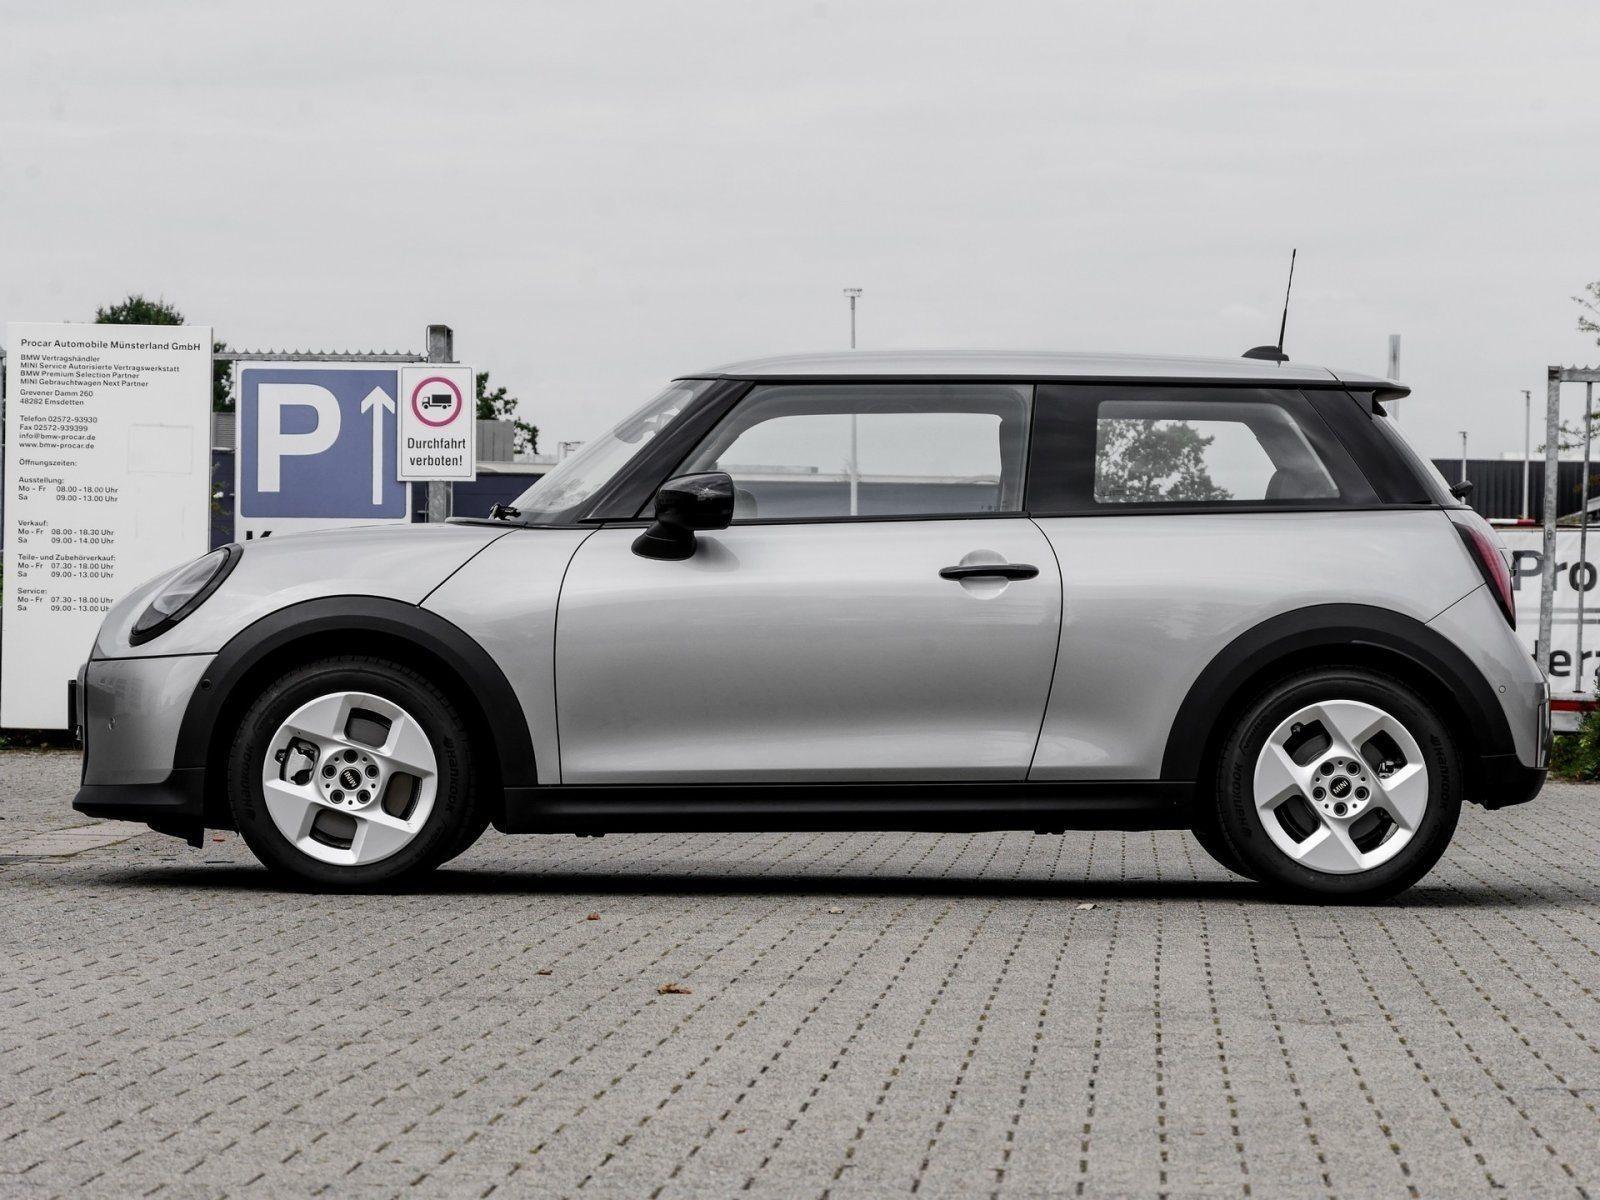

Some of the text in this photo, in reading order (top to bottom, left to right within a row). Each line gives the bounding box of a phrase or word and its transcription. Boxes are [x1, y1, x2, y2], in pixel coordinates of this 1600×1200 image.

[20, 338, 201, 351] Procar Automobile Münsterland GmbH
[42, 354, 100, 363] Vertragshändler
[39, 378, 101, 387] Gebrauchtwagen
[19, 433, 96, 441] info@bmw-procar.de
[257, 383, 341, 492] P
[407, 437, 466, 449] Durchfahrt
[409, 455, 462, 466] verboten!
[19, 476, 64, 485] Ausstellung:
[344, 770, 357, 788] MINI
[1332, 780, 1348, 795] MINI
